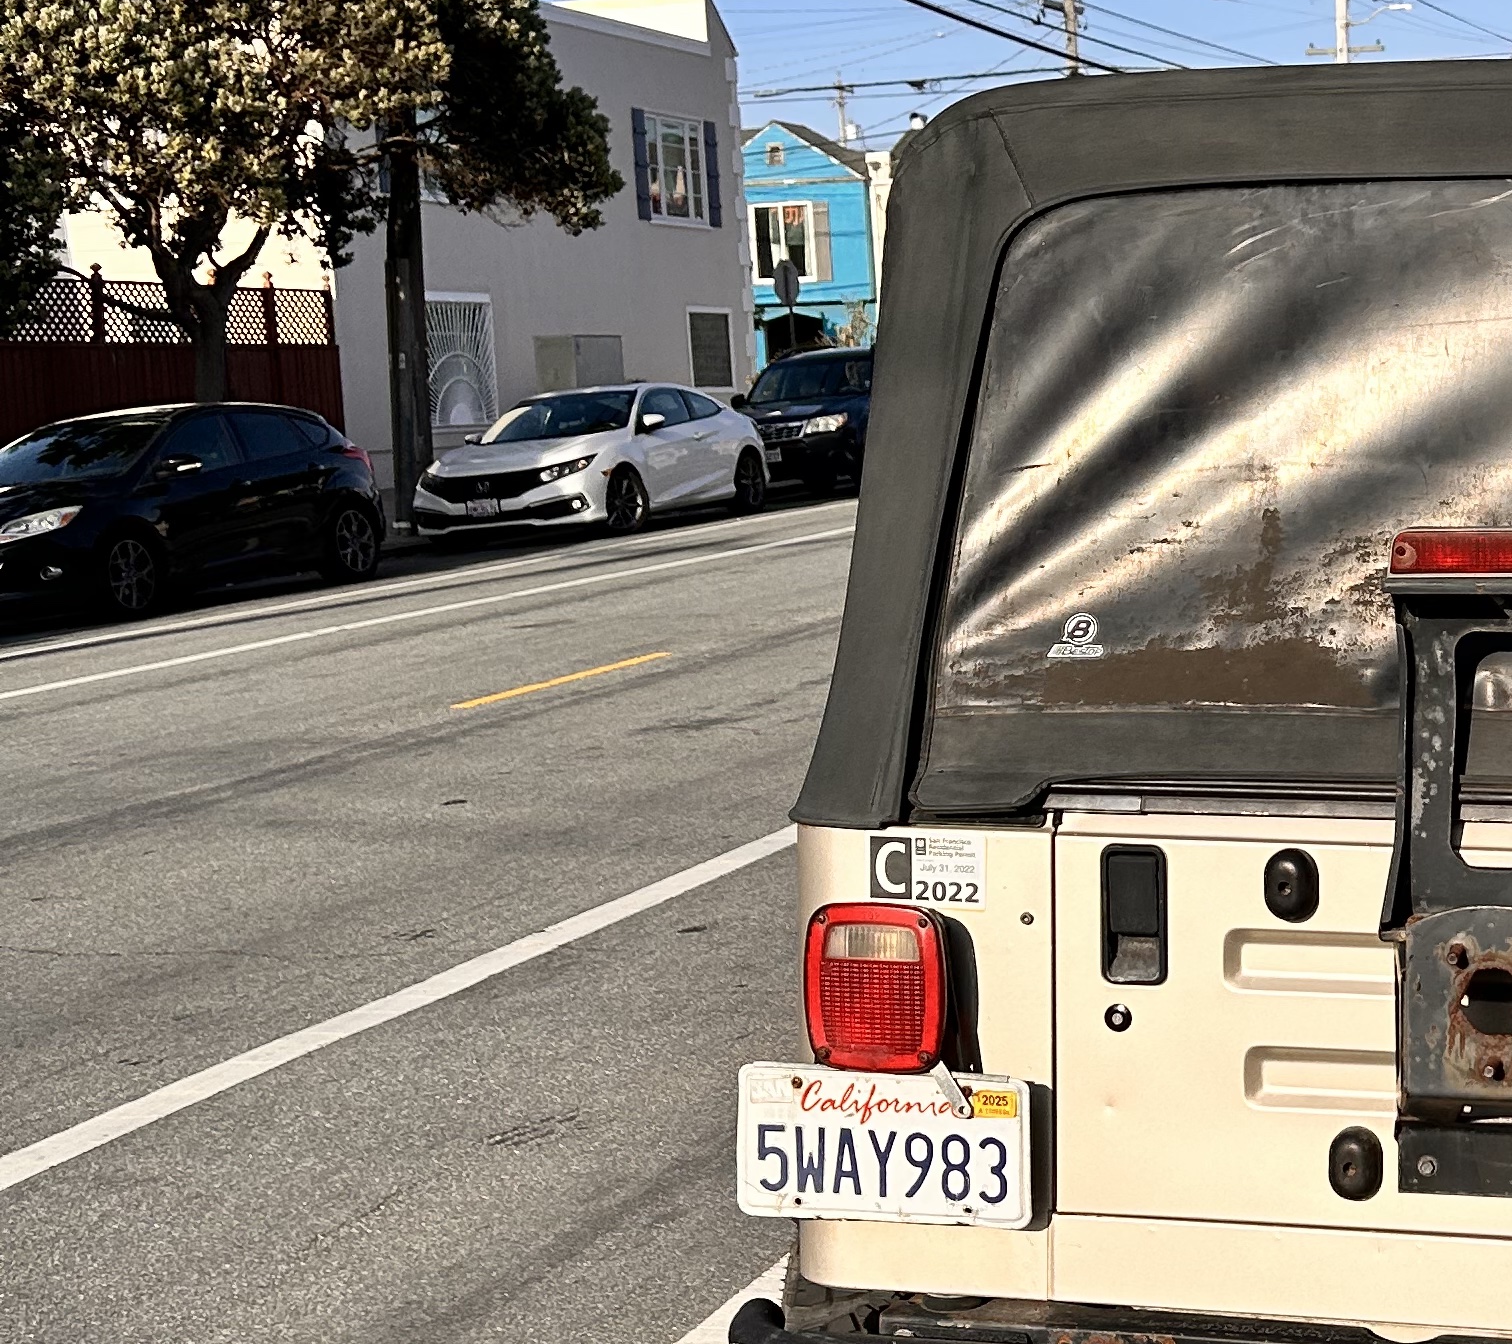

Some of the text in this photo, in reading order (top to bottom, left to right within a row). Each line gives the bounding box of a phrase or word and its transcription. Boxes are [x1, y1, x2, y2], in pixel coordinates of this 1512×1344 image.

[875, 841, 906, 894] C
[920, 863, 938, 873] July
[954, 864, 975, 874] 2022
[915, 880, 979, 903] 2022
[800, 1080, 958, 1124] California
[982, 1094, 1008, 1107] 2025
[757, 1123, 1008, 1204] 5WAY983
